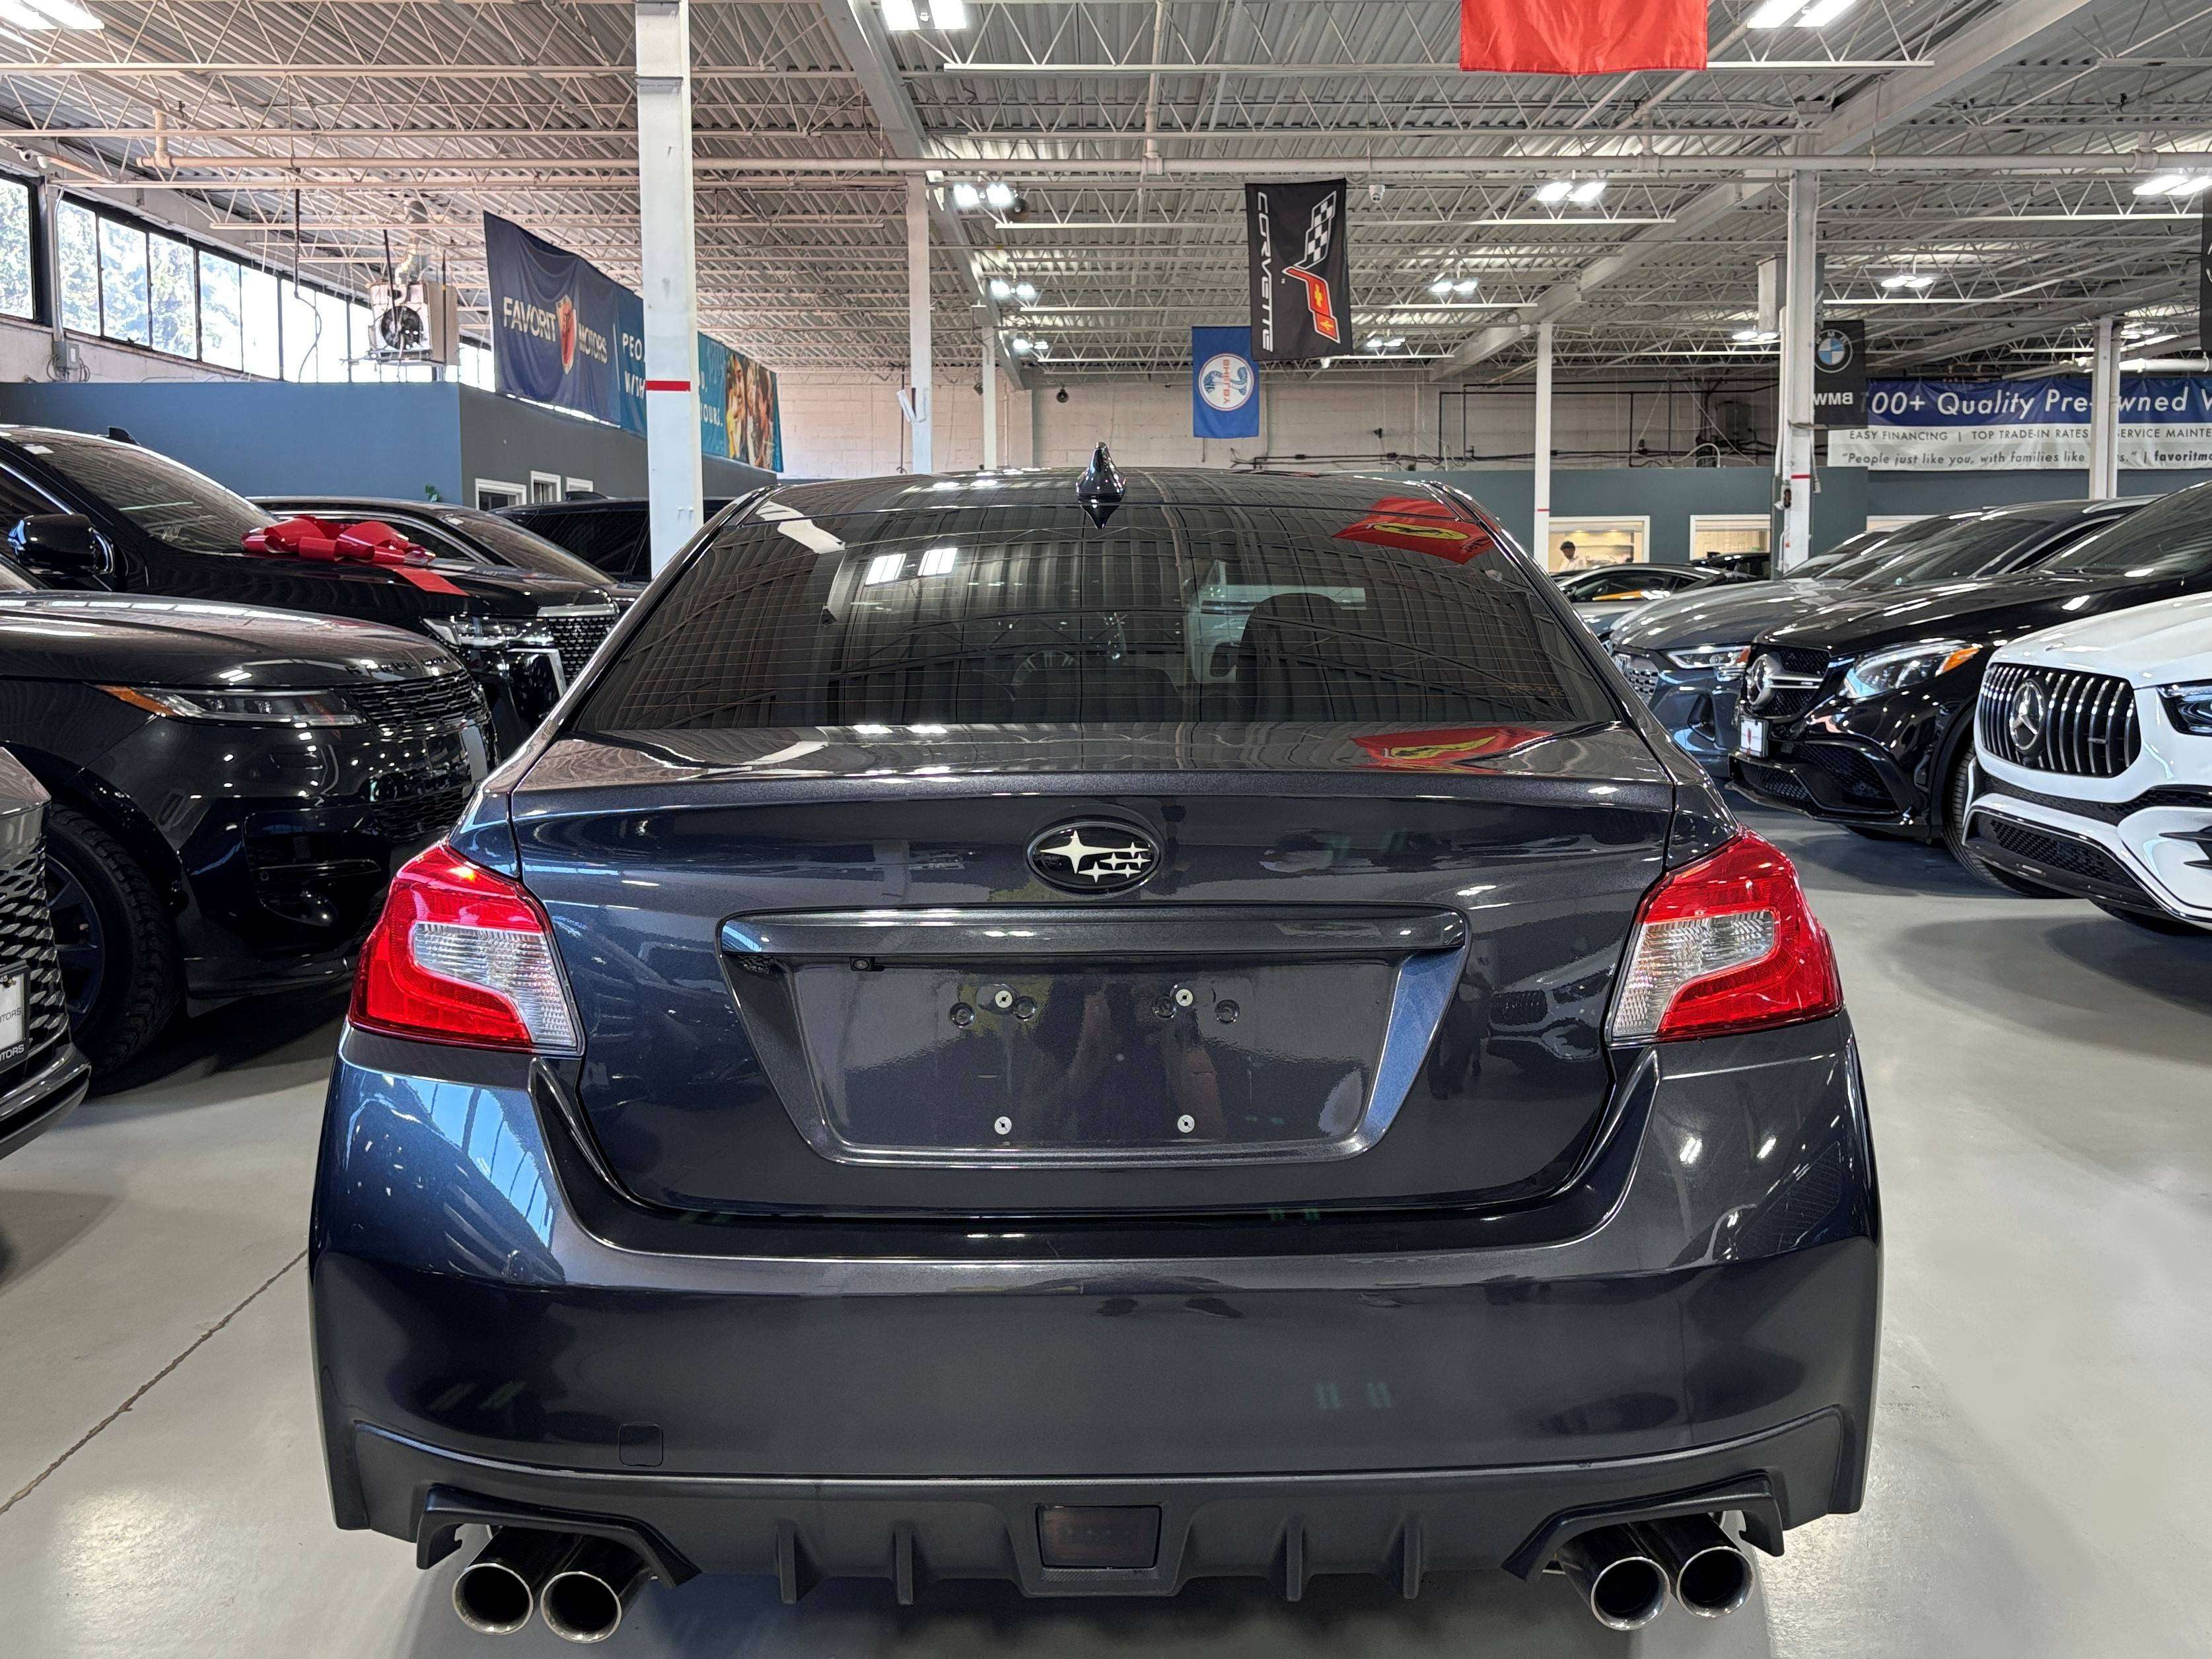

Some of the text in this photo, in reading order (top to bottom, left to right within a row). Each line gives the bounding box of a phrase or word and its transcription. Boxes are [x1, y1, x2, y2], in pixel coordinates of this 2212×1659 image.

[1257, 192, 1274, 353] CORVETTE
[503, 297, 608, 364] FAVORIT MOTORS
[624, 371, 646, 400] WITH
[1937, 389, 2035, 420] Quality
[1850, 430, 1878, 440] EASY
[1883, 431, 1948, 441] FINANCING
[1972, 430, 1995, 440] TOP
[2055, 429, 2088, 439] RATES
[2166, 428, 2212, 439] MAINTE
[1894, 453, 1918, 465] just
[1923, 452, 1944, 464] like
[1949, 455, 1974, 466] you,
[1981, 452, 2005, 463] with
[2011, 451, 2059, 463] families
[2064, 450, 2085, 462] like
